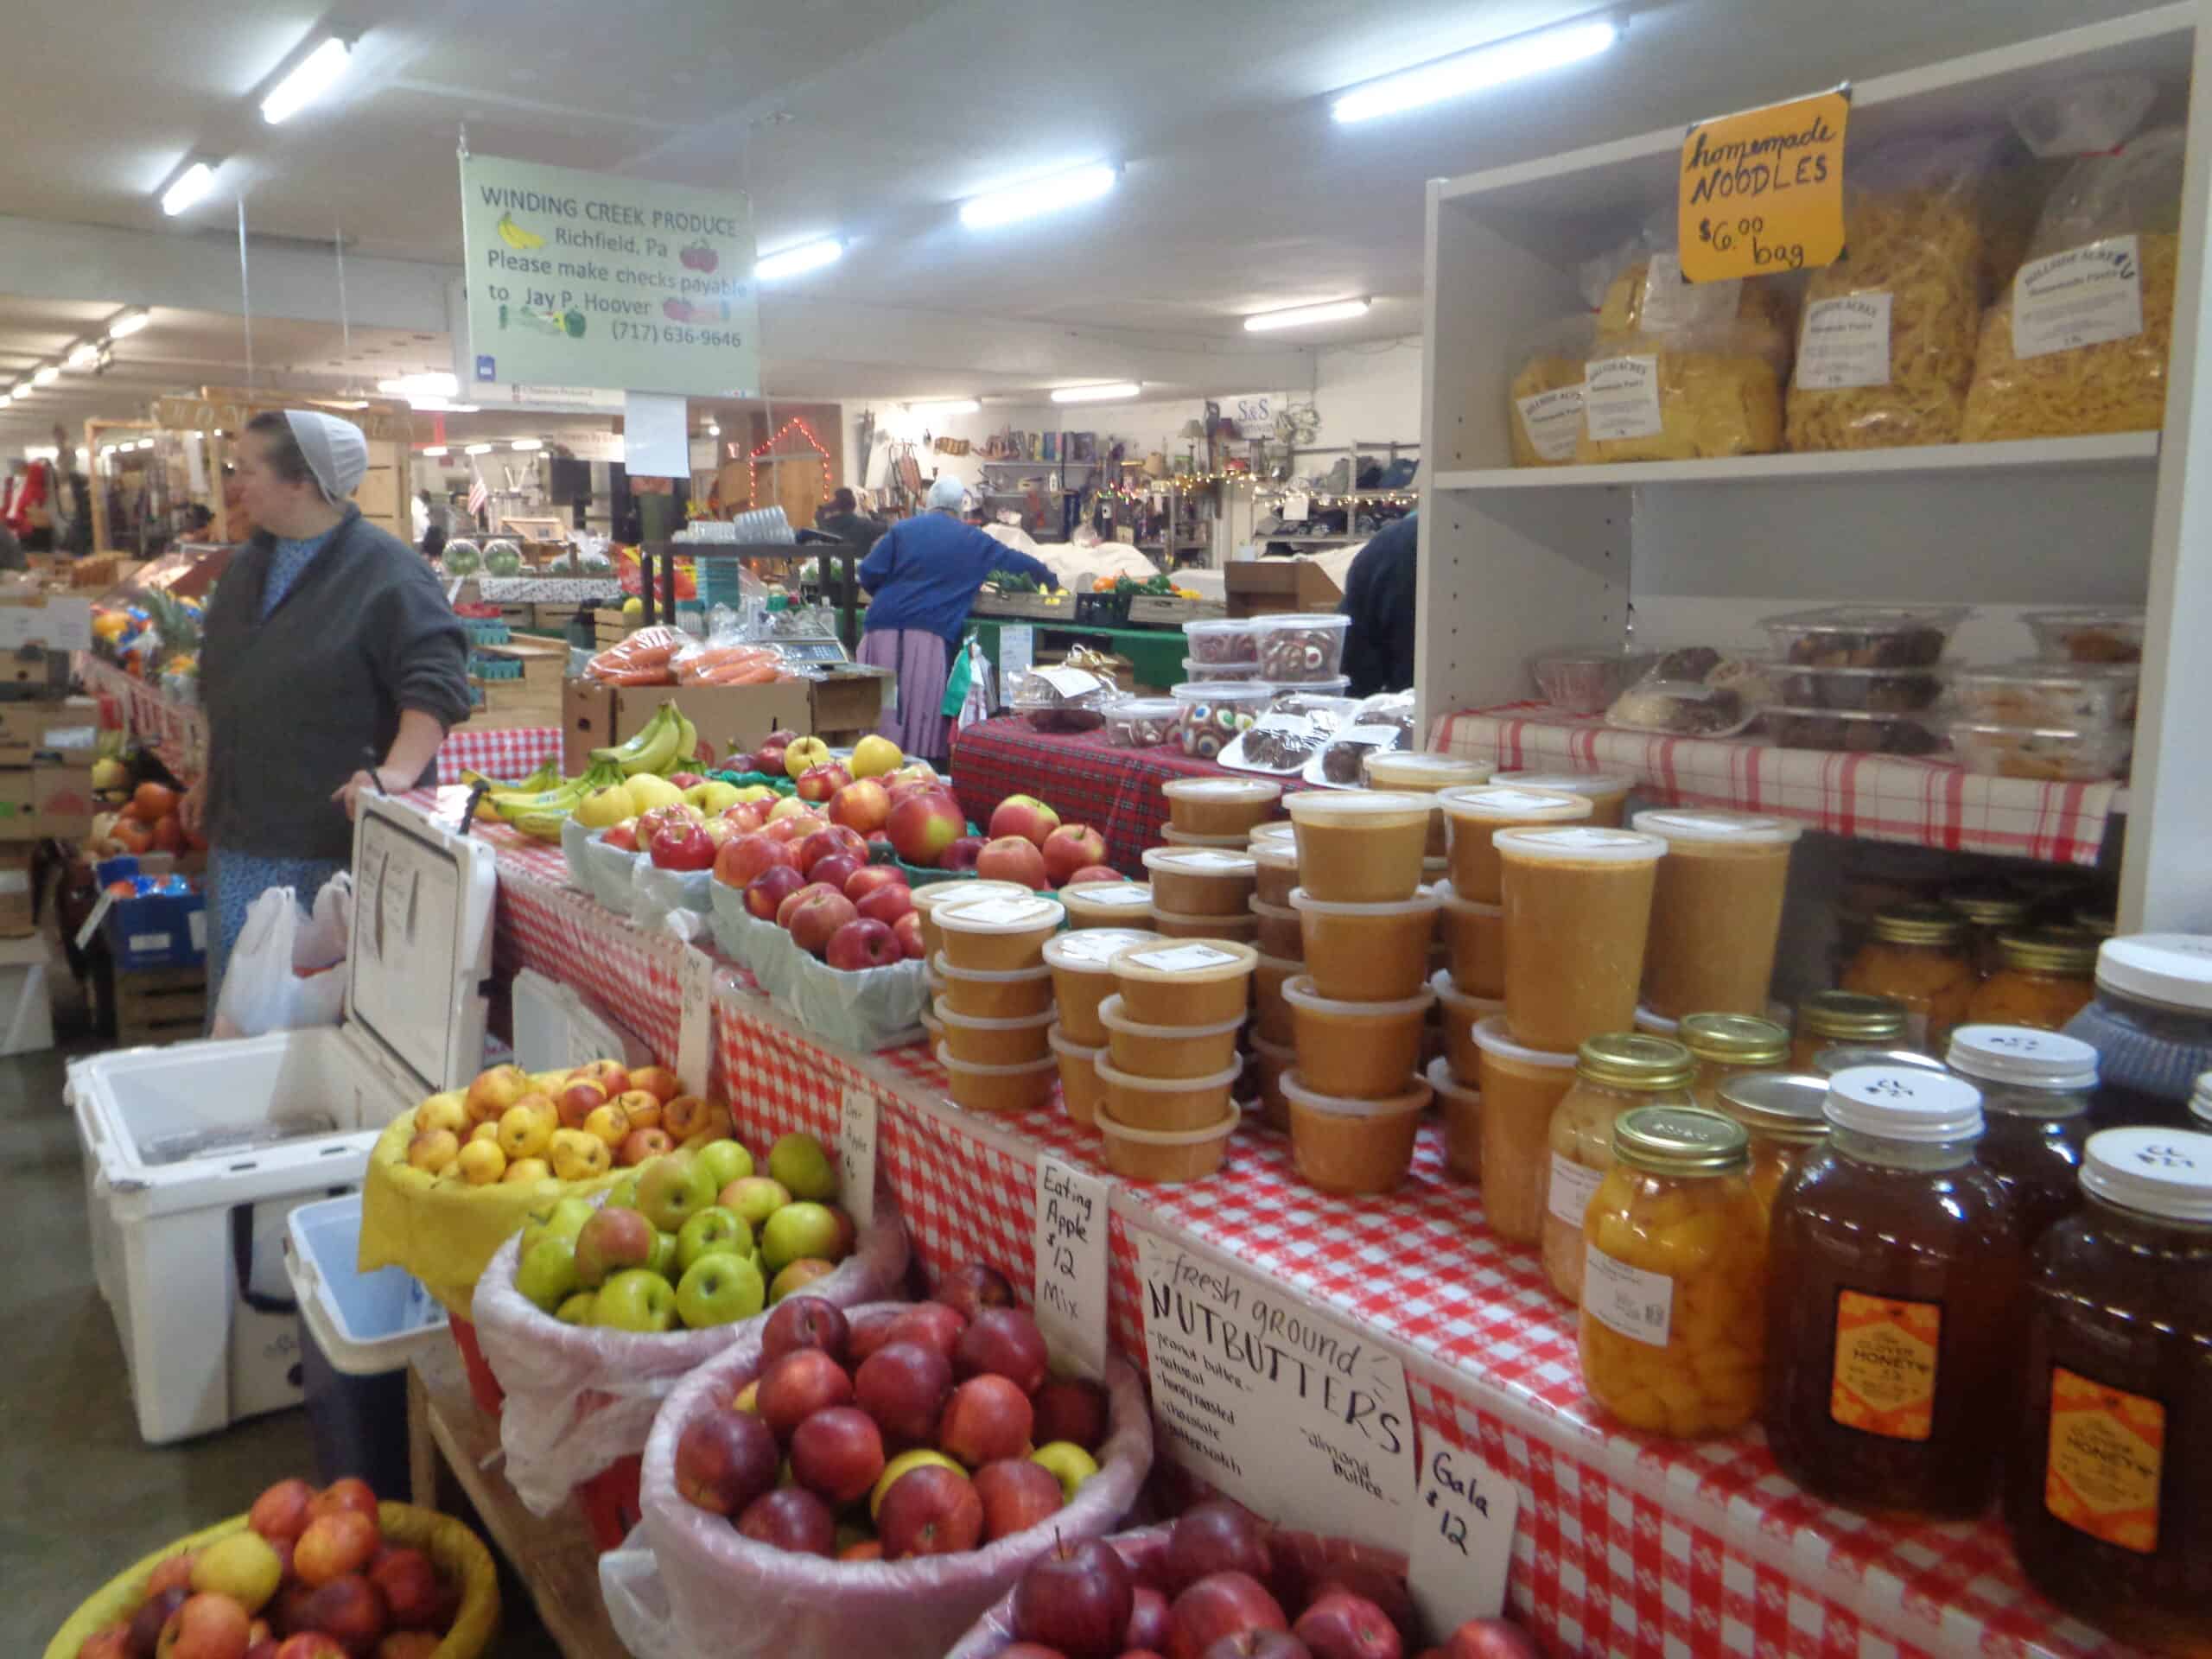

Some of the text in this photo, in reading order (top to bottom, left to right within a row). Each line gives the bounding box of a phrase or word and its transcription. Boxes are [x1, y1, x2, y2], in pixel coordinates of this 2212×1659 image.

[1687, 117, 1836, 172] homemade
[1690, 153, 1827, 206] NOODLES
[480, 186, 739, 237] WINDING CREEK PRODUCE
[646, 237, 668, 258] Pa
[1752, 236, 1804, 269] bag
[487, 249, 747, 298] Please make checks payable
[488, 284, 510, 301] to
[524, 286, 555, 309] Jay
[584, 291, 652, 315] Hoover
[612, 320, 741, 348] (717) 636-9646
[1237, 398, 1269, 421] S&S
[1044, 1165, 1093, 1221] Eating
[1046, 1198, 1088, 1244] Apple
[1043, 1279, 1078, 1320] Mix
[1433, 1452, 1489, 1518] Gala
